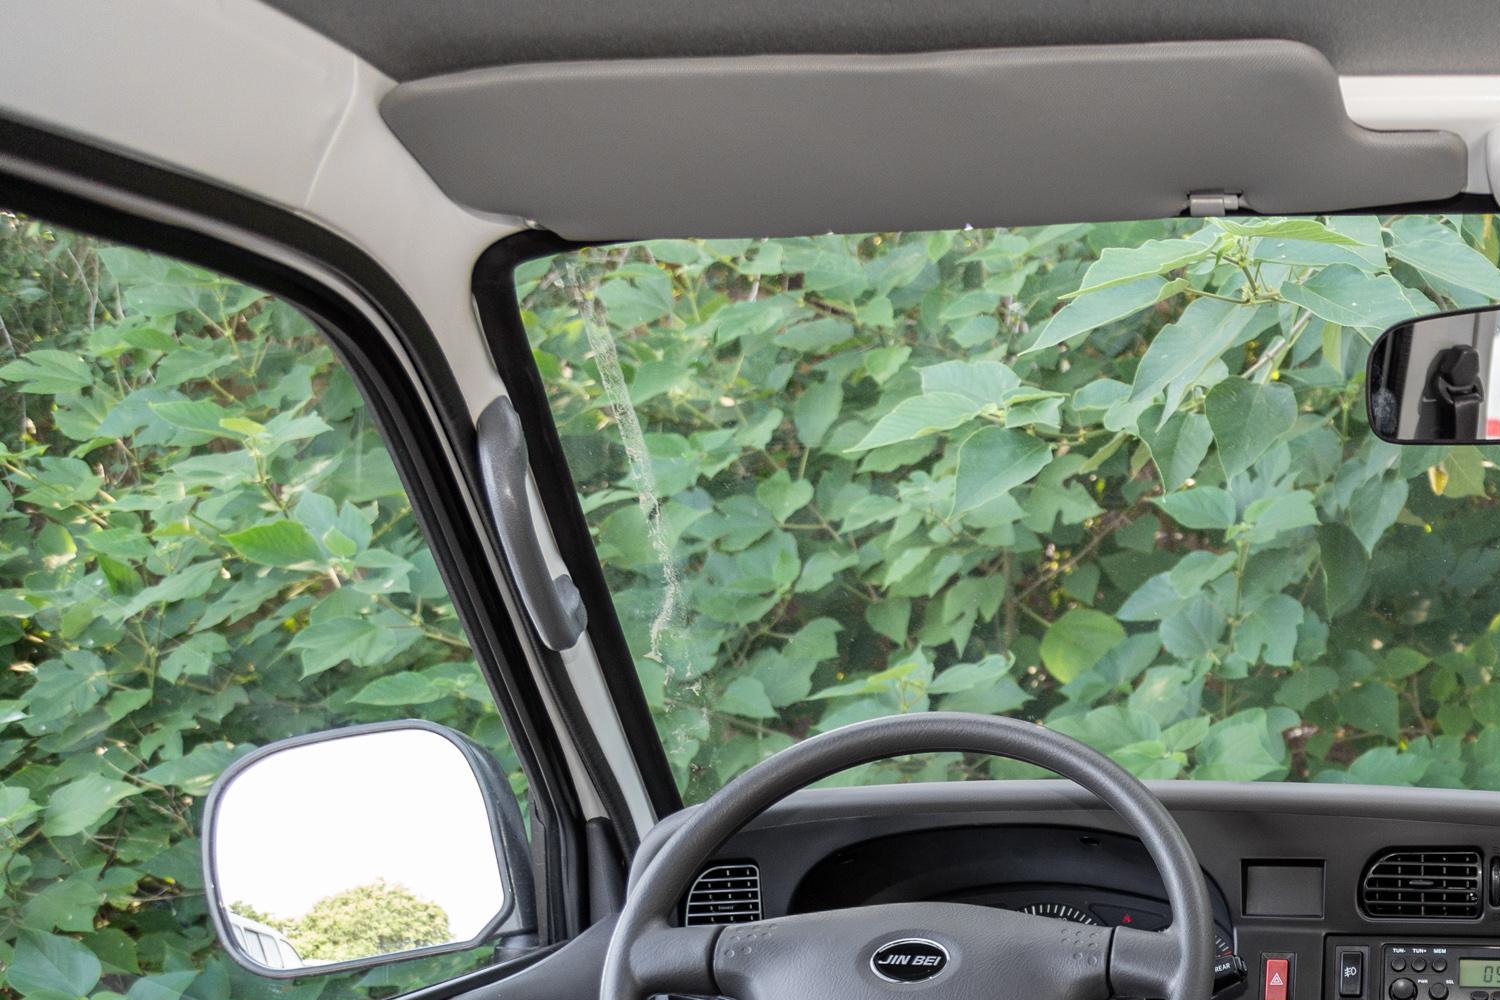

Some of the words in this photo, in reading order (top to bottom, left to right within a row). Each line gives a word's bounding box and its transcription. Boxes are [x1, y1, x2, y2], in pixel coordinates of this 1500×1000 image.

[878, 954, 911, 965] JIN
[911, 955, 941, 966] BEI
[1214, 962, 1231, 973] REAR
